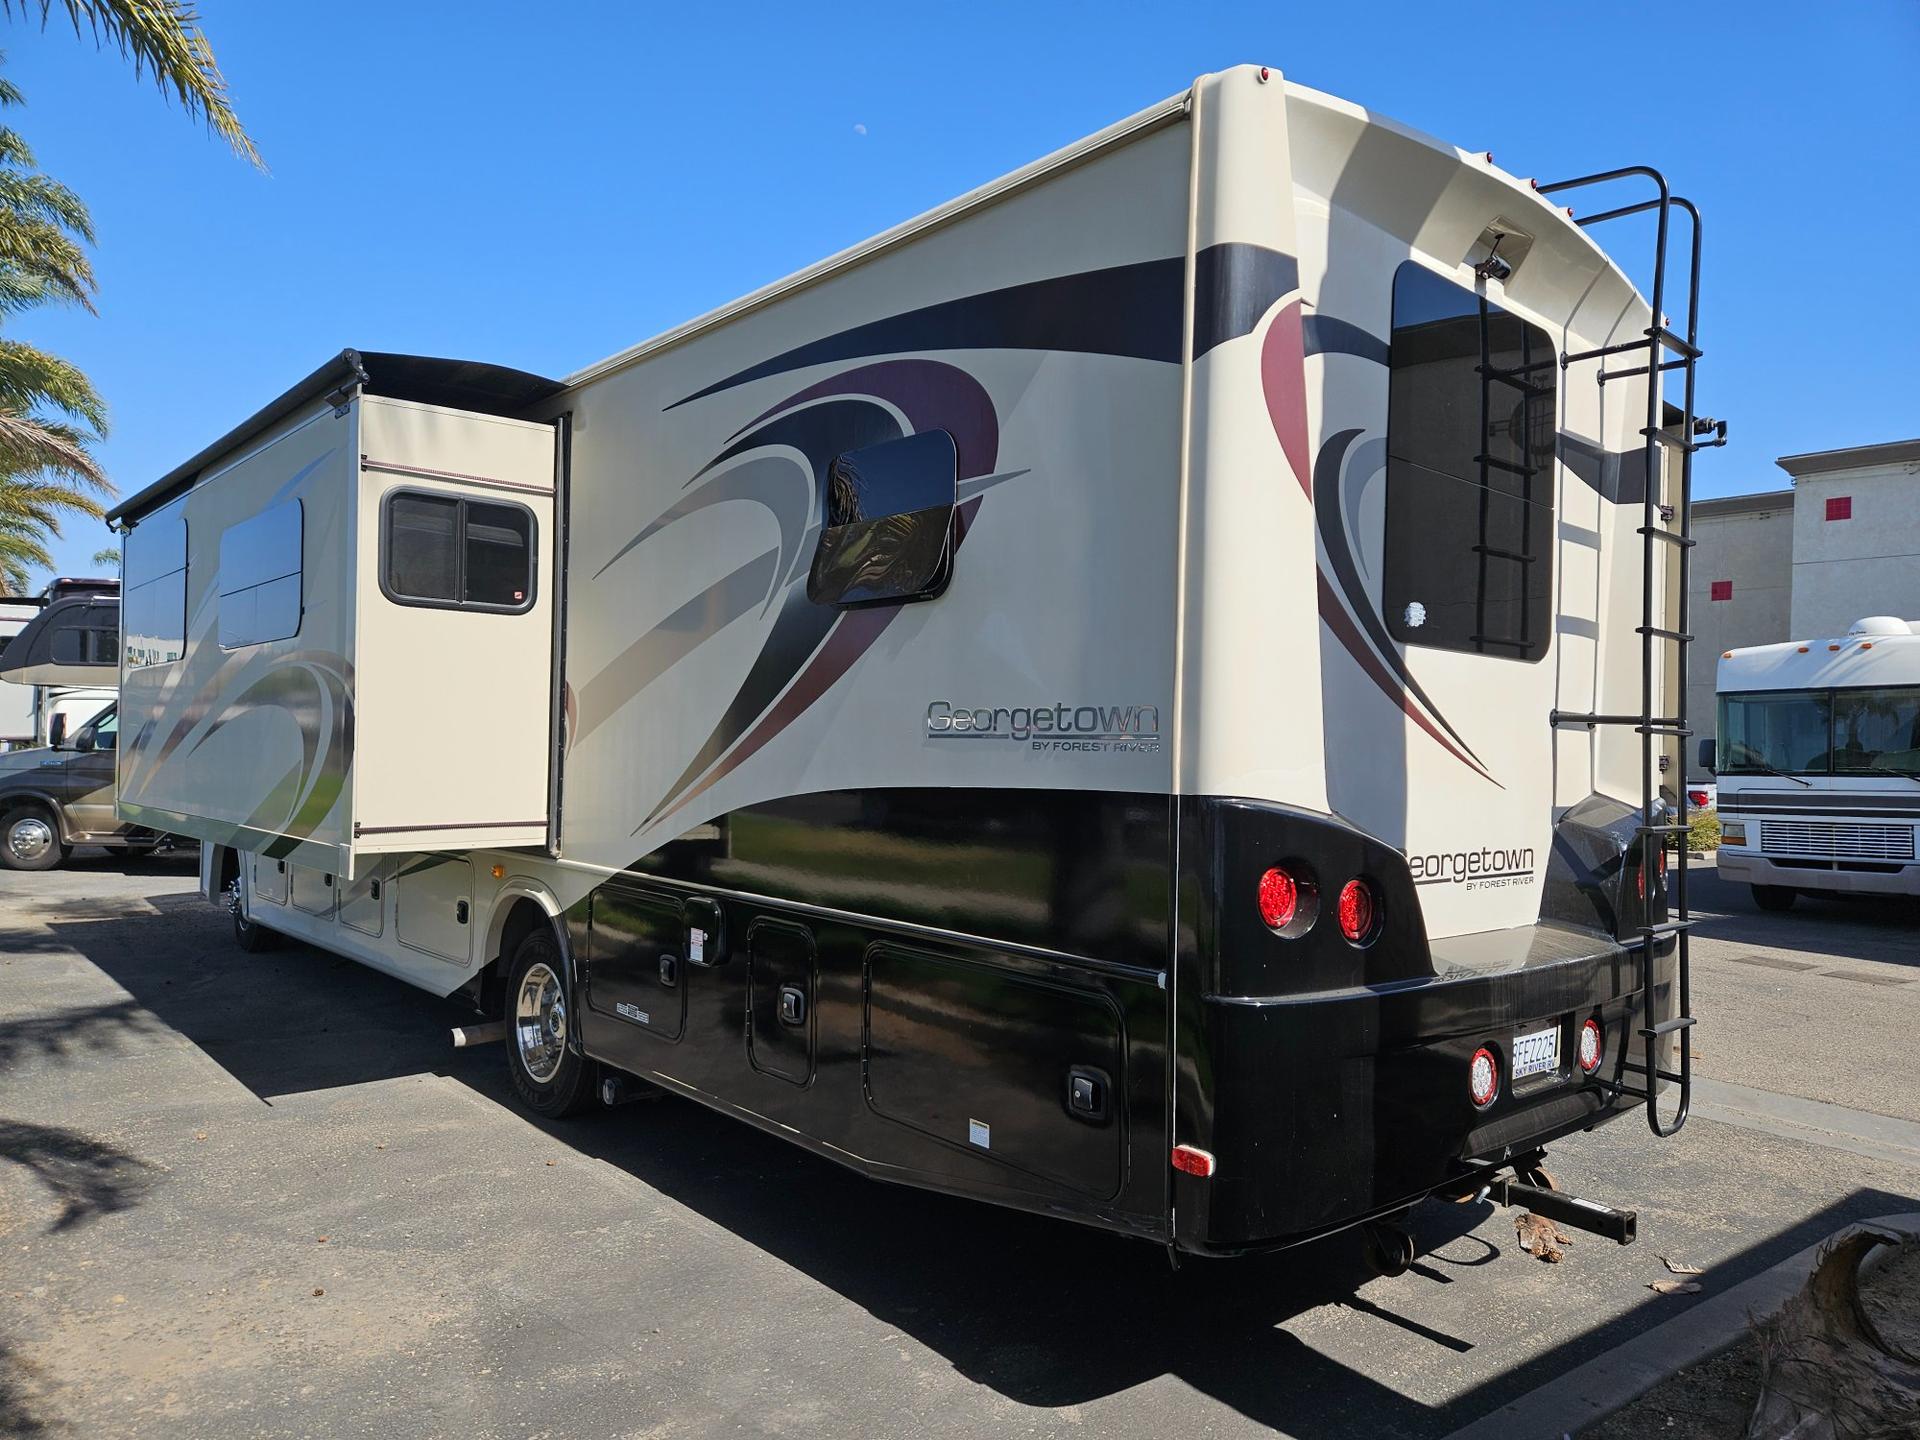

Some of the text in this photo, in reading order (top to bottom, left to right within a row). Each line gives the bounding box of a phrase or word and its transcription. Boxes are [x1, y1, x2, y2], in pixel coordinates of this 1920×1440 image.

[928, 700, 1159, 741] Georgetown
[1032, 741, 1160, 753] BY FOREST RIVER
[1409, 847, 1534, 883] eorgetown
[1466, 876, 1534, 891] BY FOREST RIVER
[1515, 1067, 1527, 1077] SKY
[1528, 1062, 1546, 1073] RIVER
